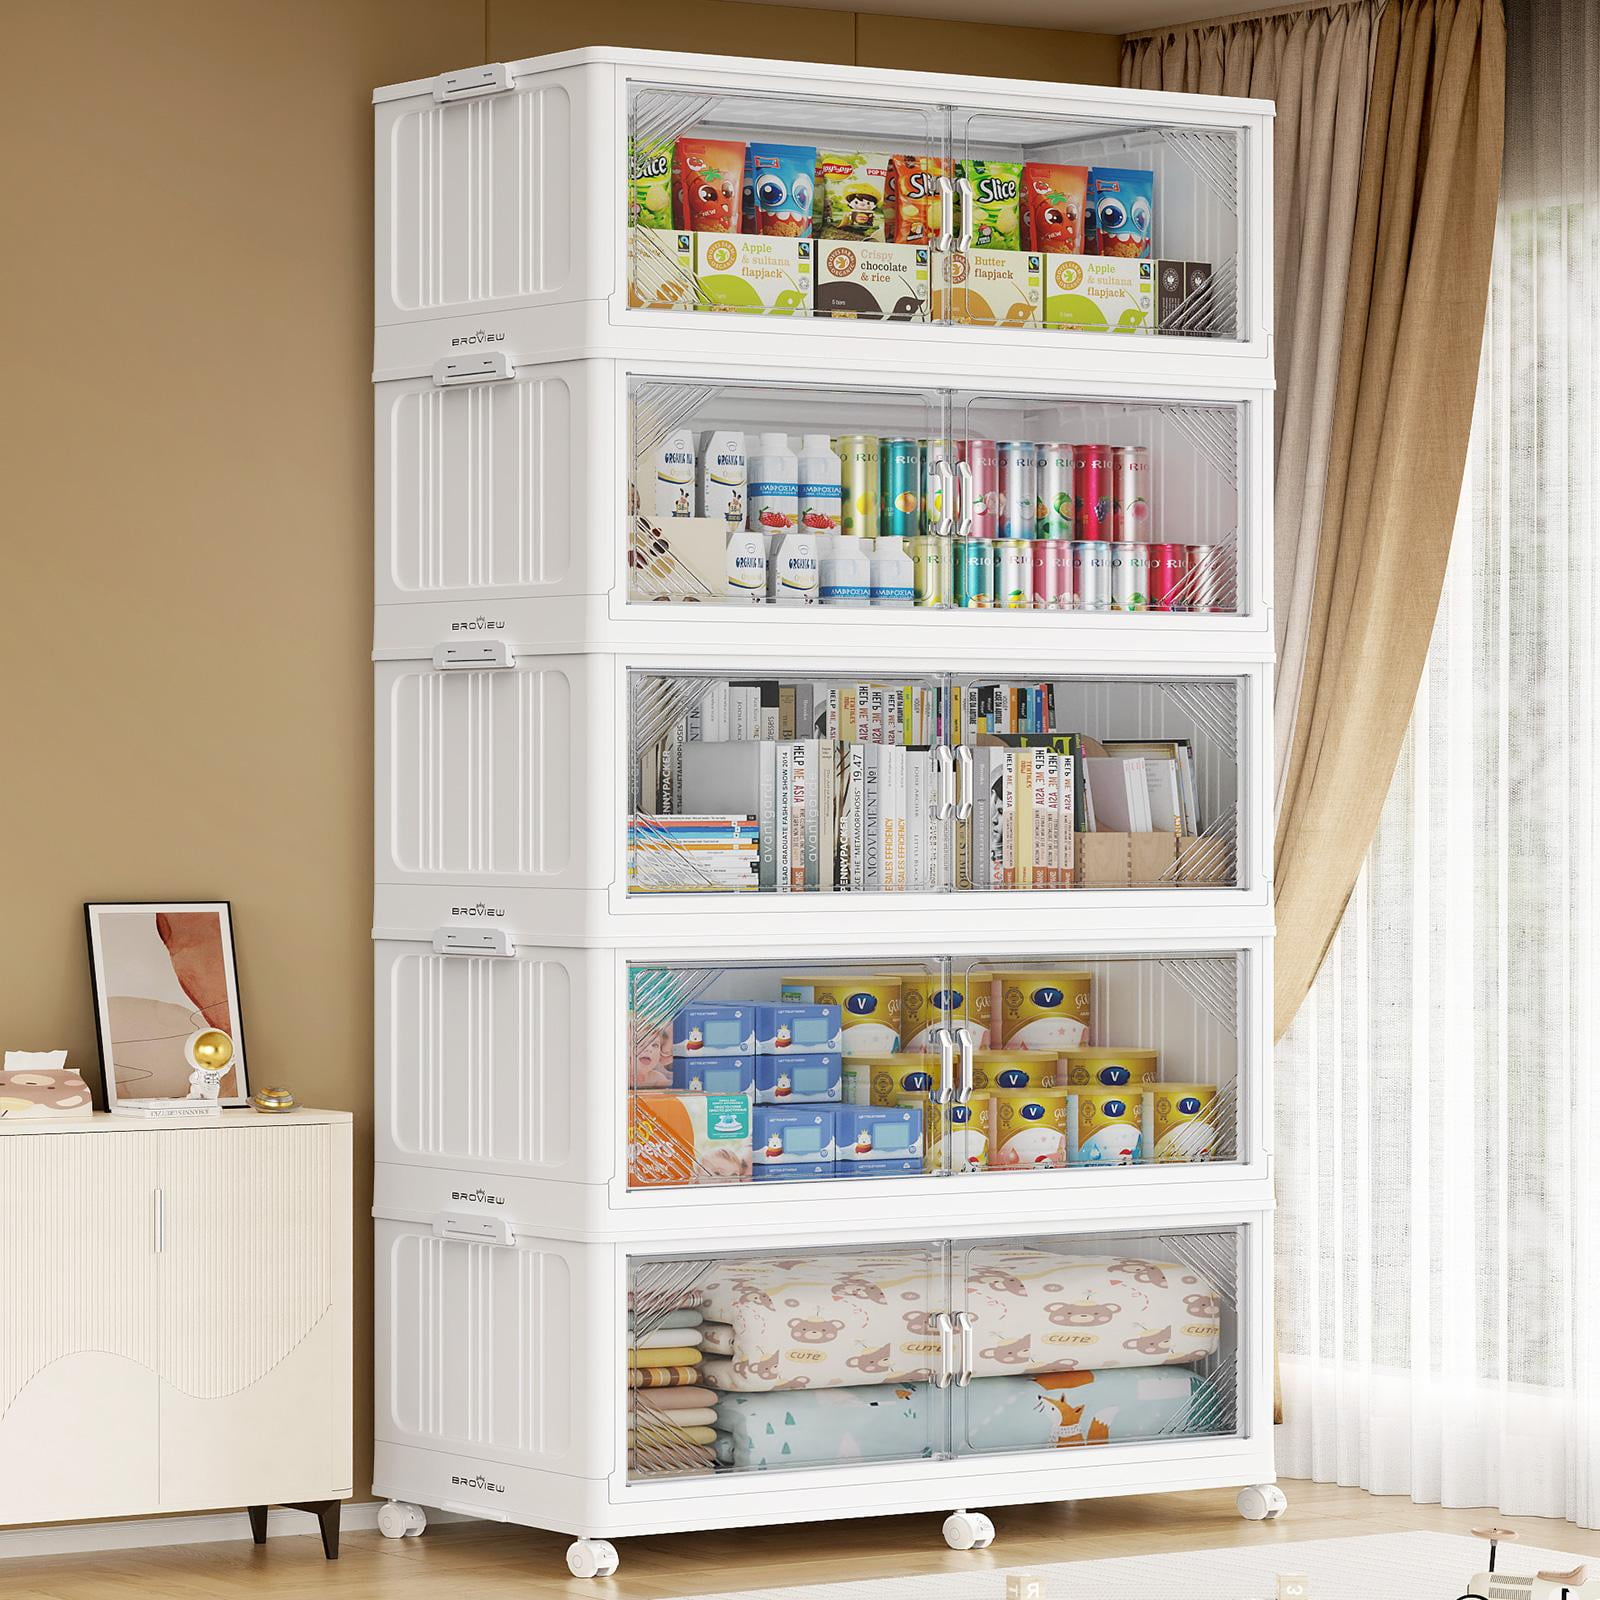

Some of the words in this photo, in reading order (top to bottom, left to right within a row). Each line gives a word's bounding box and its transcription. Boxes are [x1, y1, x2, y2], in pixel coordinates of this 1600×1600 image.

[978, 178, 1016, 203] Slice
[741, 242, 772, 254] Apple
[742, 255, 749, 264] &
[752, 255, 790, 266] sultana
[860, 249, 894, 261] Crispy
[860, 261, 908, 272] chocolate
[974, 256, 1006, 267] Butter
[741, 267, 783, 279] flapjack
[974, 268, 1014, 280] flapjack
[1087, 263, 1116, 274] Apple
[860, 272, 869, 281] &
[871, 272, 891, 282] rice
[1088, 275, 1095, 284] &
[1097, 276, 1132, 286] sultana
[1087, 286, 1126, 298] flapjack
[451, 333, 505, 346] BROVIEW
[451, 621, 505, 631] BROVIEW
[793, 745, 804, 766] HELP
[793, 785, 804, 803] ASIA
[885, 817, 894, 859] EFFICIENCY
[897, 817, 905, 858] EFFICIENCY
[885, 861, 894, 884] SALES
[897, 860, 905, 882] SALES
[451, 907, 505, 917] BROVIEW
[1044, 992, 1053, 1003] V
[857, 998, 866, 1010] V
[914, 1076, 923, 1088] V
[1009, 1074, 1018, 1085] V
[1110, 1071, 1119, 1082] V
[1111, 1104, 1118, 1114] V
[1186, 1101, 1194, 1111] V
[957, 1110, 964, 1120] V
[1029, 1107, 1037, 1117] V
[451, 1192, 505, 1205] BROVIEW
[1048, 1335, 1092, 1344] CUTE
[790, 1350, 821, 1361] CUTE
[451, 1476, 505, 1493] BROVIEW
